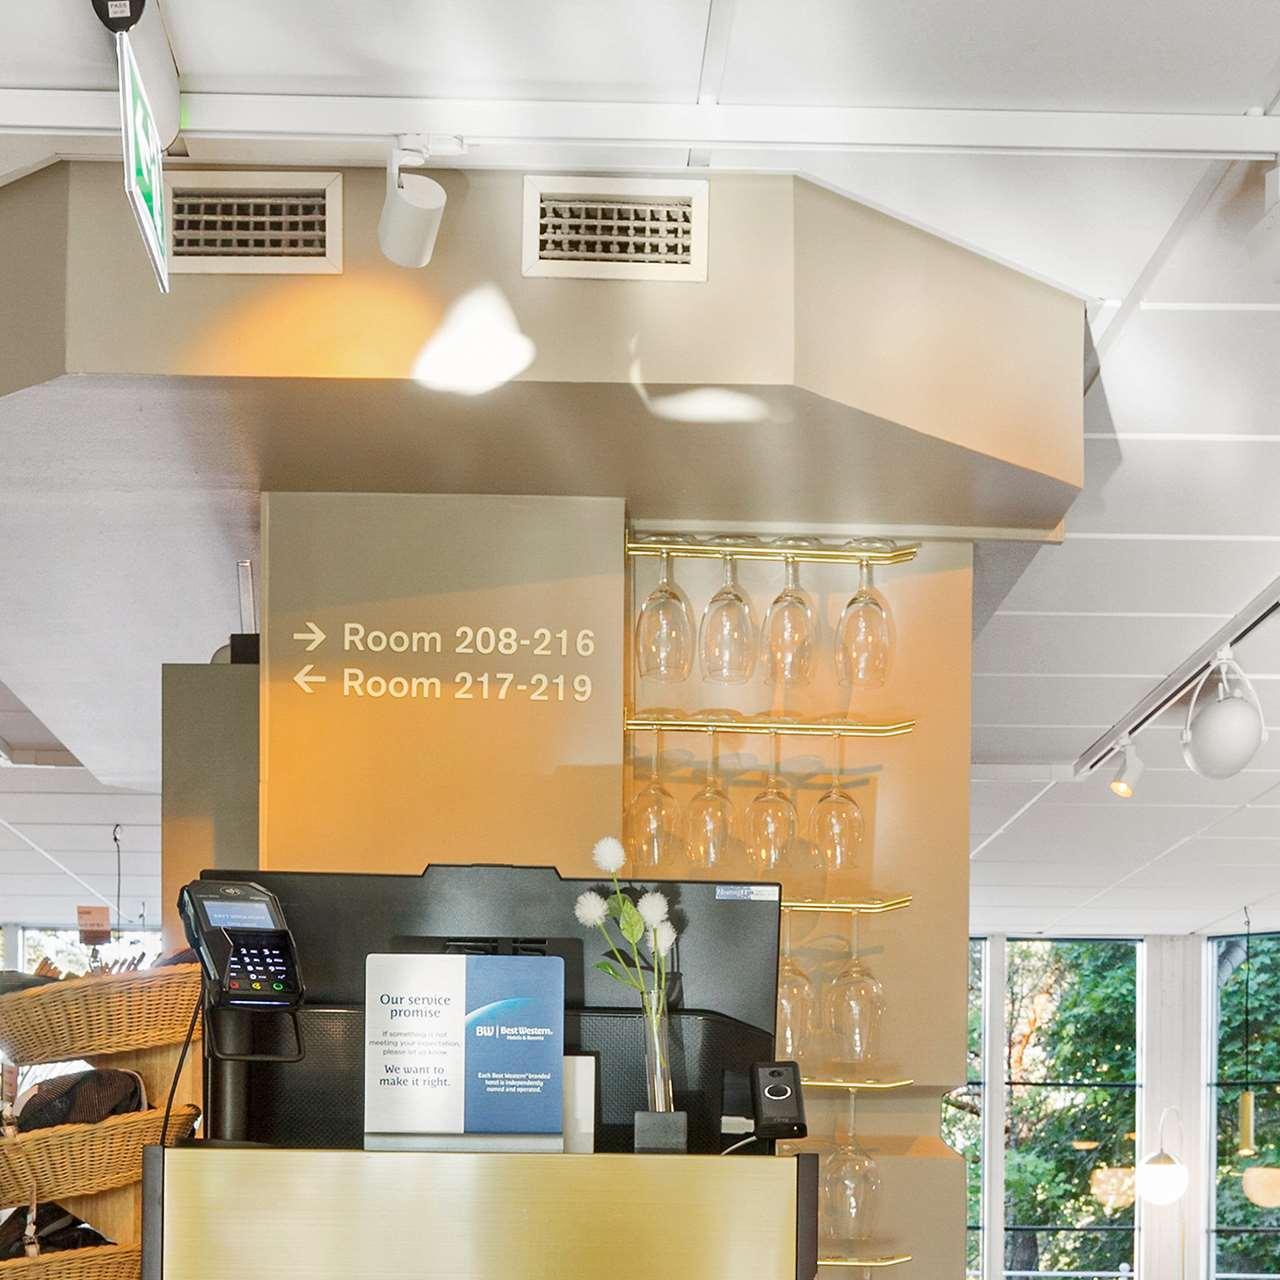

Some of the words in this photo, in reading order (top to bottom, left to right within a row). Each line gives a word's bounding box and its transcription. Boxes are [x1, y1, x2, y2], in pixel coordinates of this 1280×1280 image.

[343, 623, 441, 652] Room
[455, 626, 595, 657] 208-216
[342, 668, 441, 698] Room
[454, 672, 593, 702] 217-219
[380, 994, 405, 1005] Our
[408, 996, 451, 1006] service
[390, 1008, 441, 1019] promise
[476, 1026, 494, 1036] BW
[500, 1026, 519, 1035] Best
[384, 1065, 401, 1073] We
[380, 1077, 408, 1086] make
[412, 1078, 419, 1086] it
[423, 1078, 452, 1088] right.
